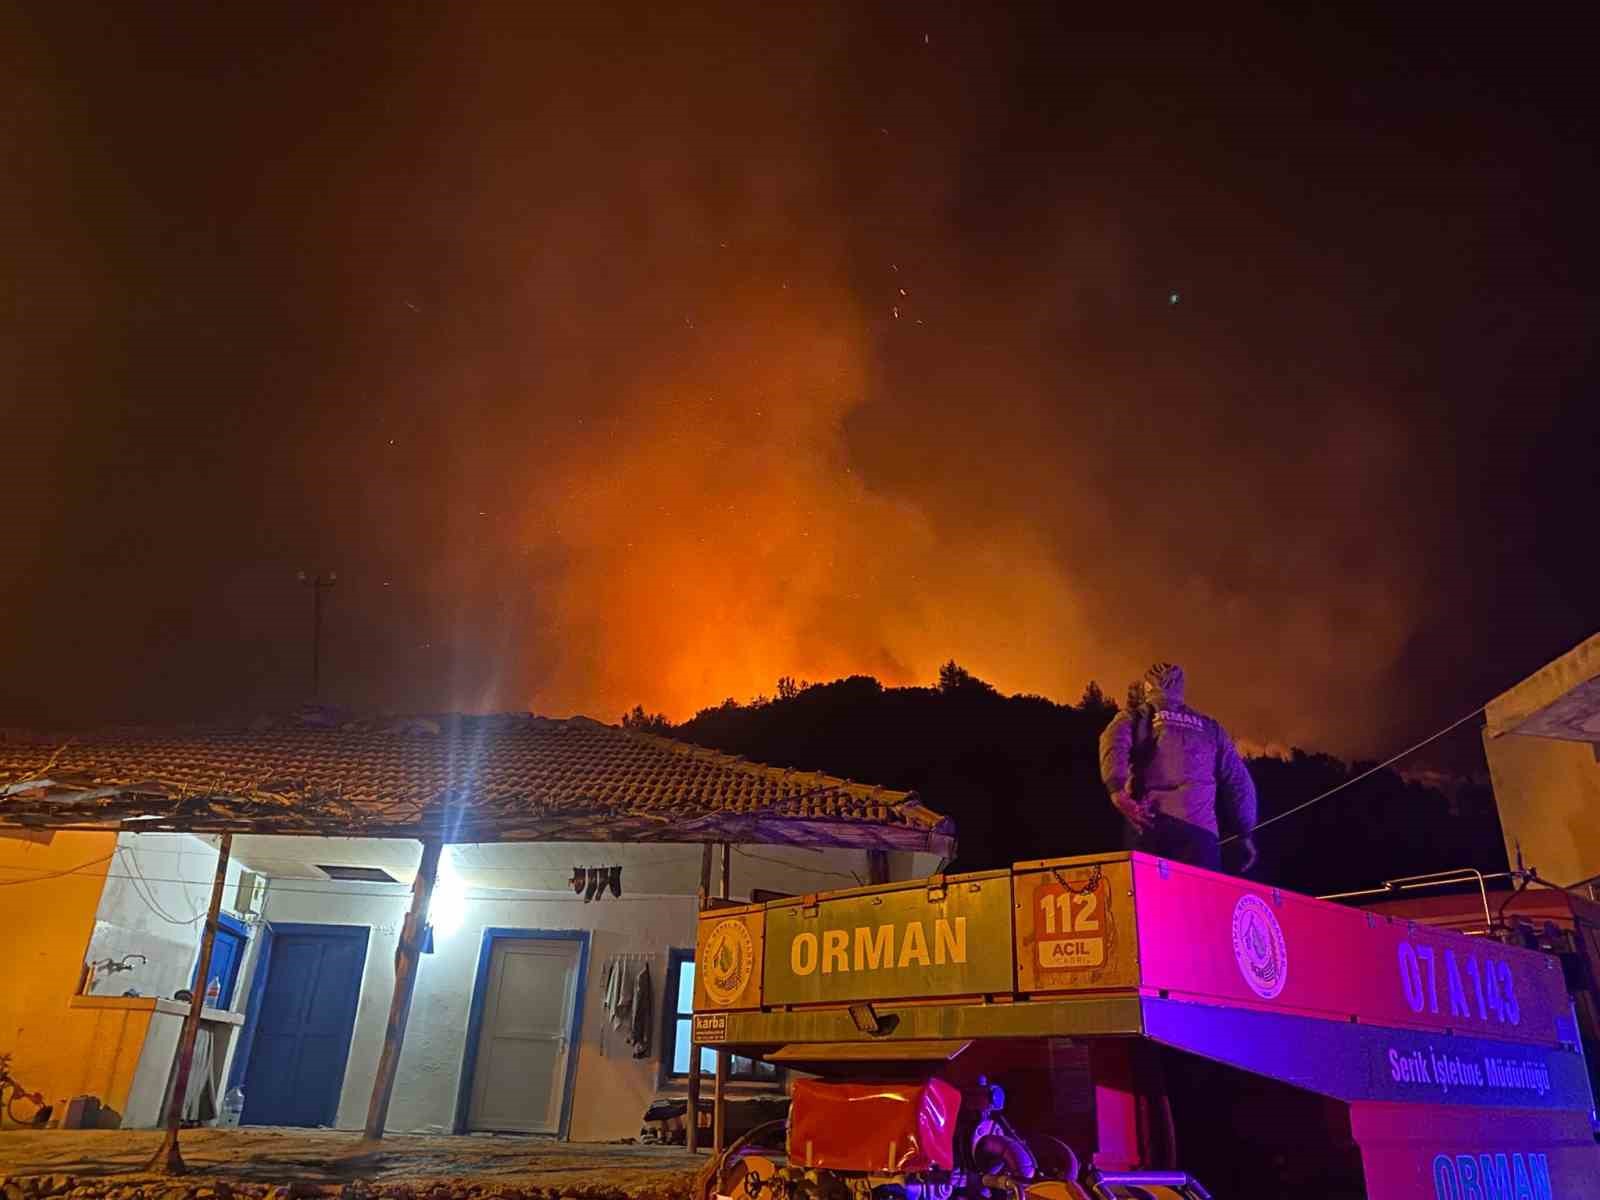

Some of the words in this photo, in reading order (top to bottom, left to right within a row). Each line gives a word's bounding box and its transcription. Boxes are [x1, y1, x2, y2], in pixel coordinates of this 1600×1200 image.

[1040, 891, 1099, 934] 112
[791, 916, 967, 976] ORMAN
[1398, 942, 1439, 1015] 07
[1444, 947, 1471, 1018] A
[1466, 953, 1521, 1026] 143
[696, 1016, 725, 1029] karba
[1388, 1048, 1431, 1083] Serik
[1433, 1153, 1552, 1200] ORMAN
